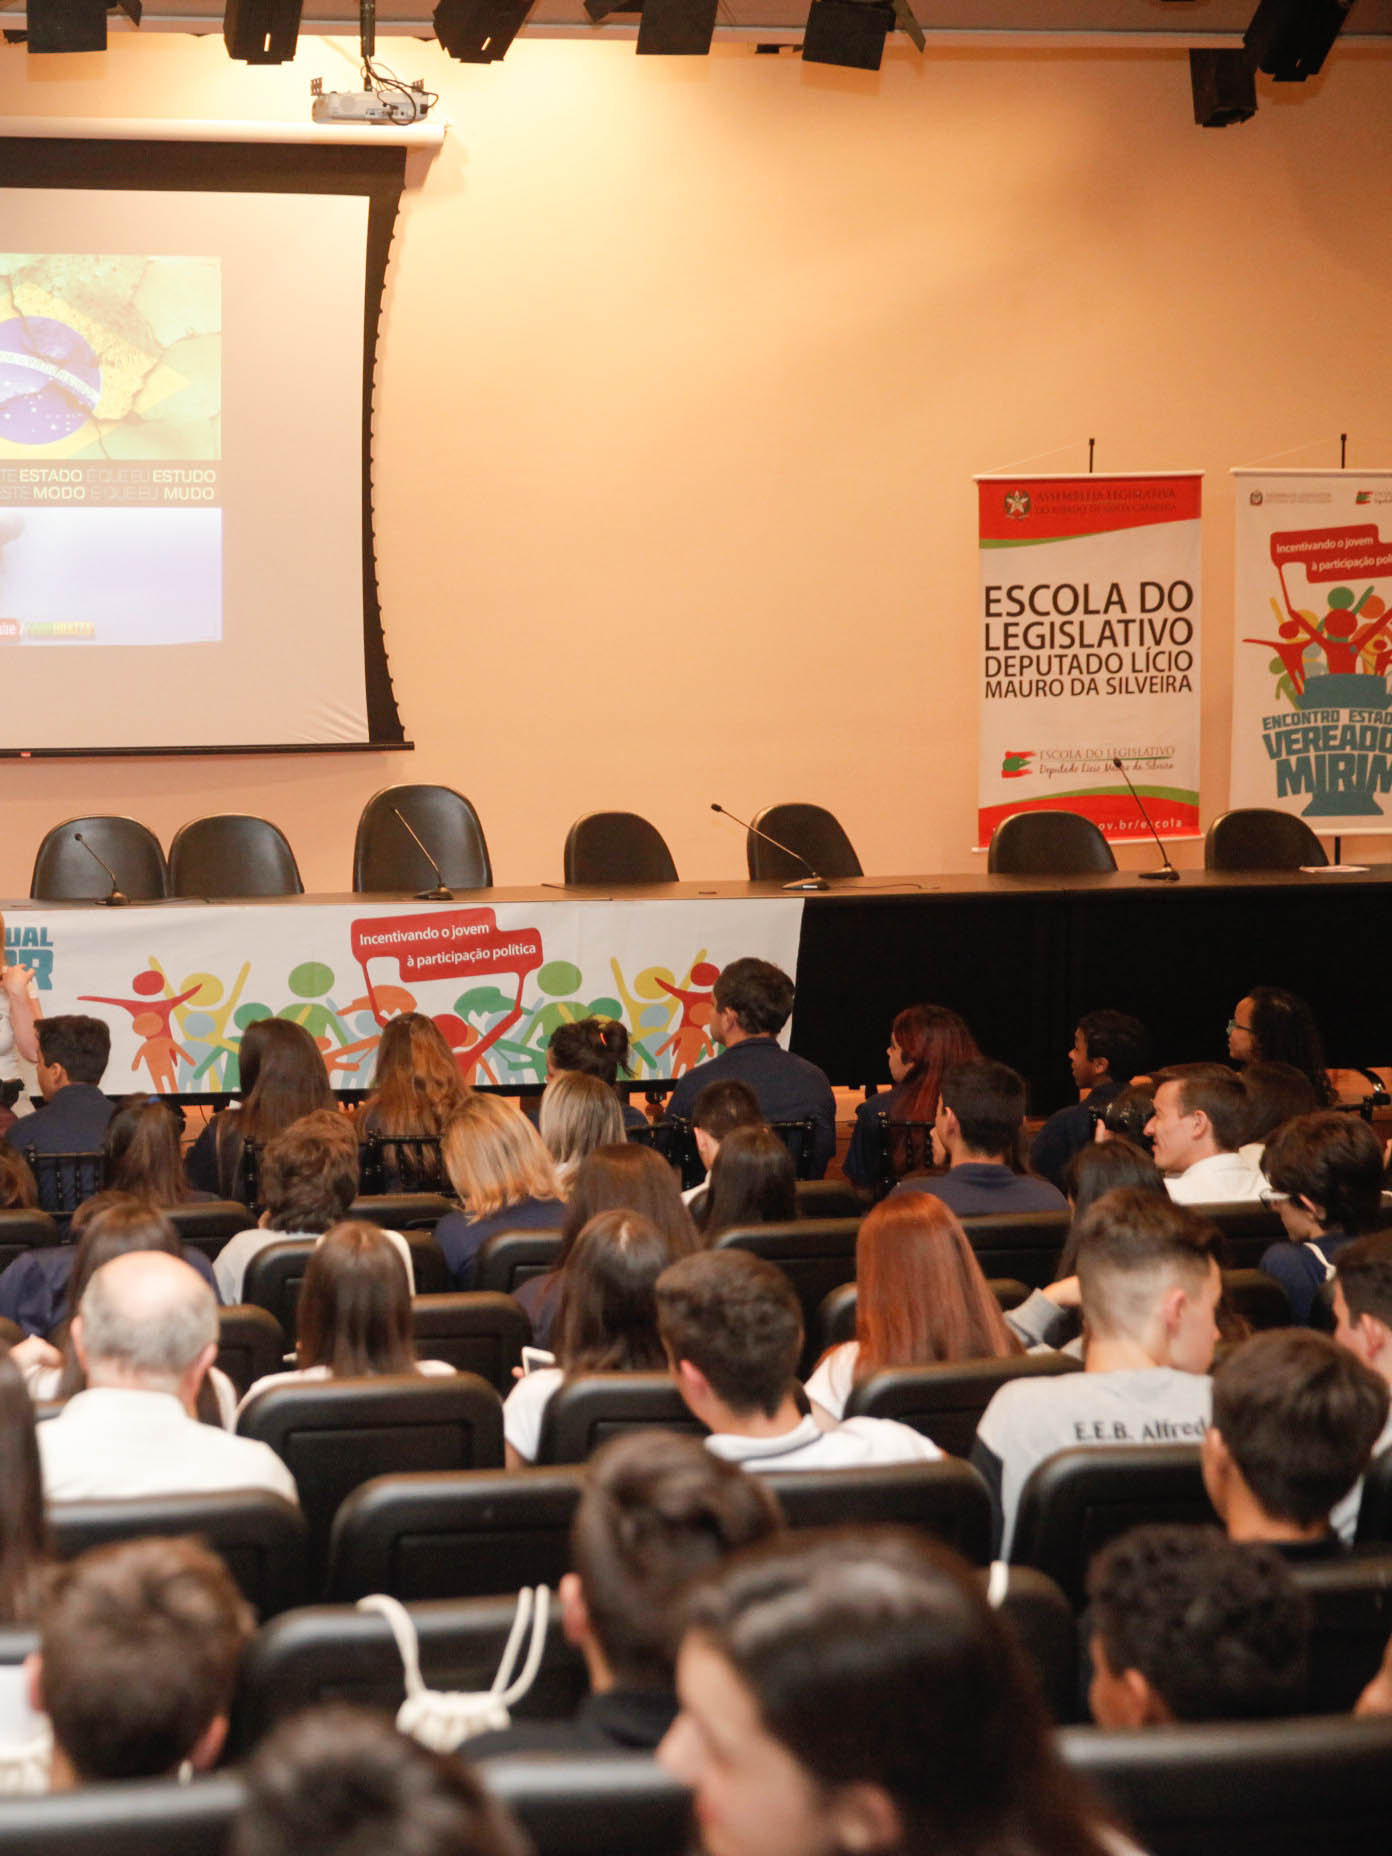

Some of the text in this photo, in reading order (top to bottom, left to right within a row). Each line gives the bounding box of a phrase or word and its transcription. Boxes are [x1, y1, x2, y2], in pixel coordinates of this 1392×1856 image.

[19, 469, 82, 482] ESTADO
[152, 469, 216, 483] ESTUDO
[33, 486, 86, 499] MODO
[163, 487, 214, 500] MUDO
[1345, 537, 1374, 549] jovem
[985, 580, 1193, 618] ESCOLA DO
[985, 617, 1193, 651] LEGISLATIVO
[985, 646, 1193, 678] DEPUTADO LÍCIO
[985, 674, 1192, 699] MAURO DA SILVEIRA
[1263, 709, 1340, 731] ENCONTRO
[1040, 745, 1175, 760] ESCOLA DO LEGISLATIVO
[360, 923, 489, 946] Incentivando o jovem
[407, 942, 536, 969] à participação política
[1073, 1421, 1131, 1440] E.E.B.
